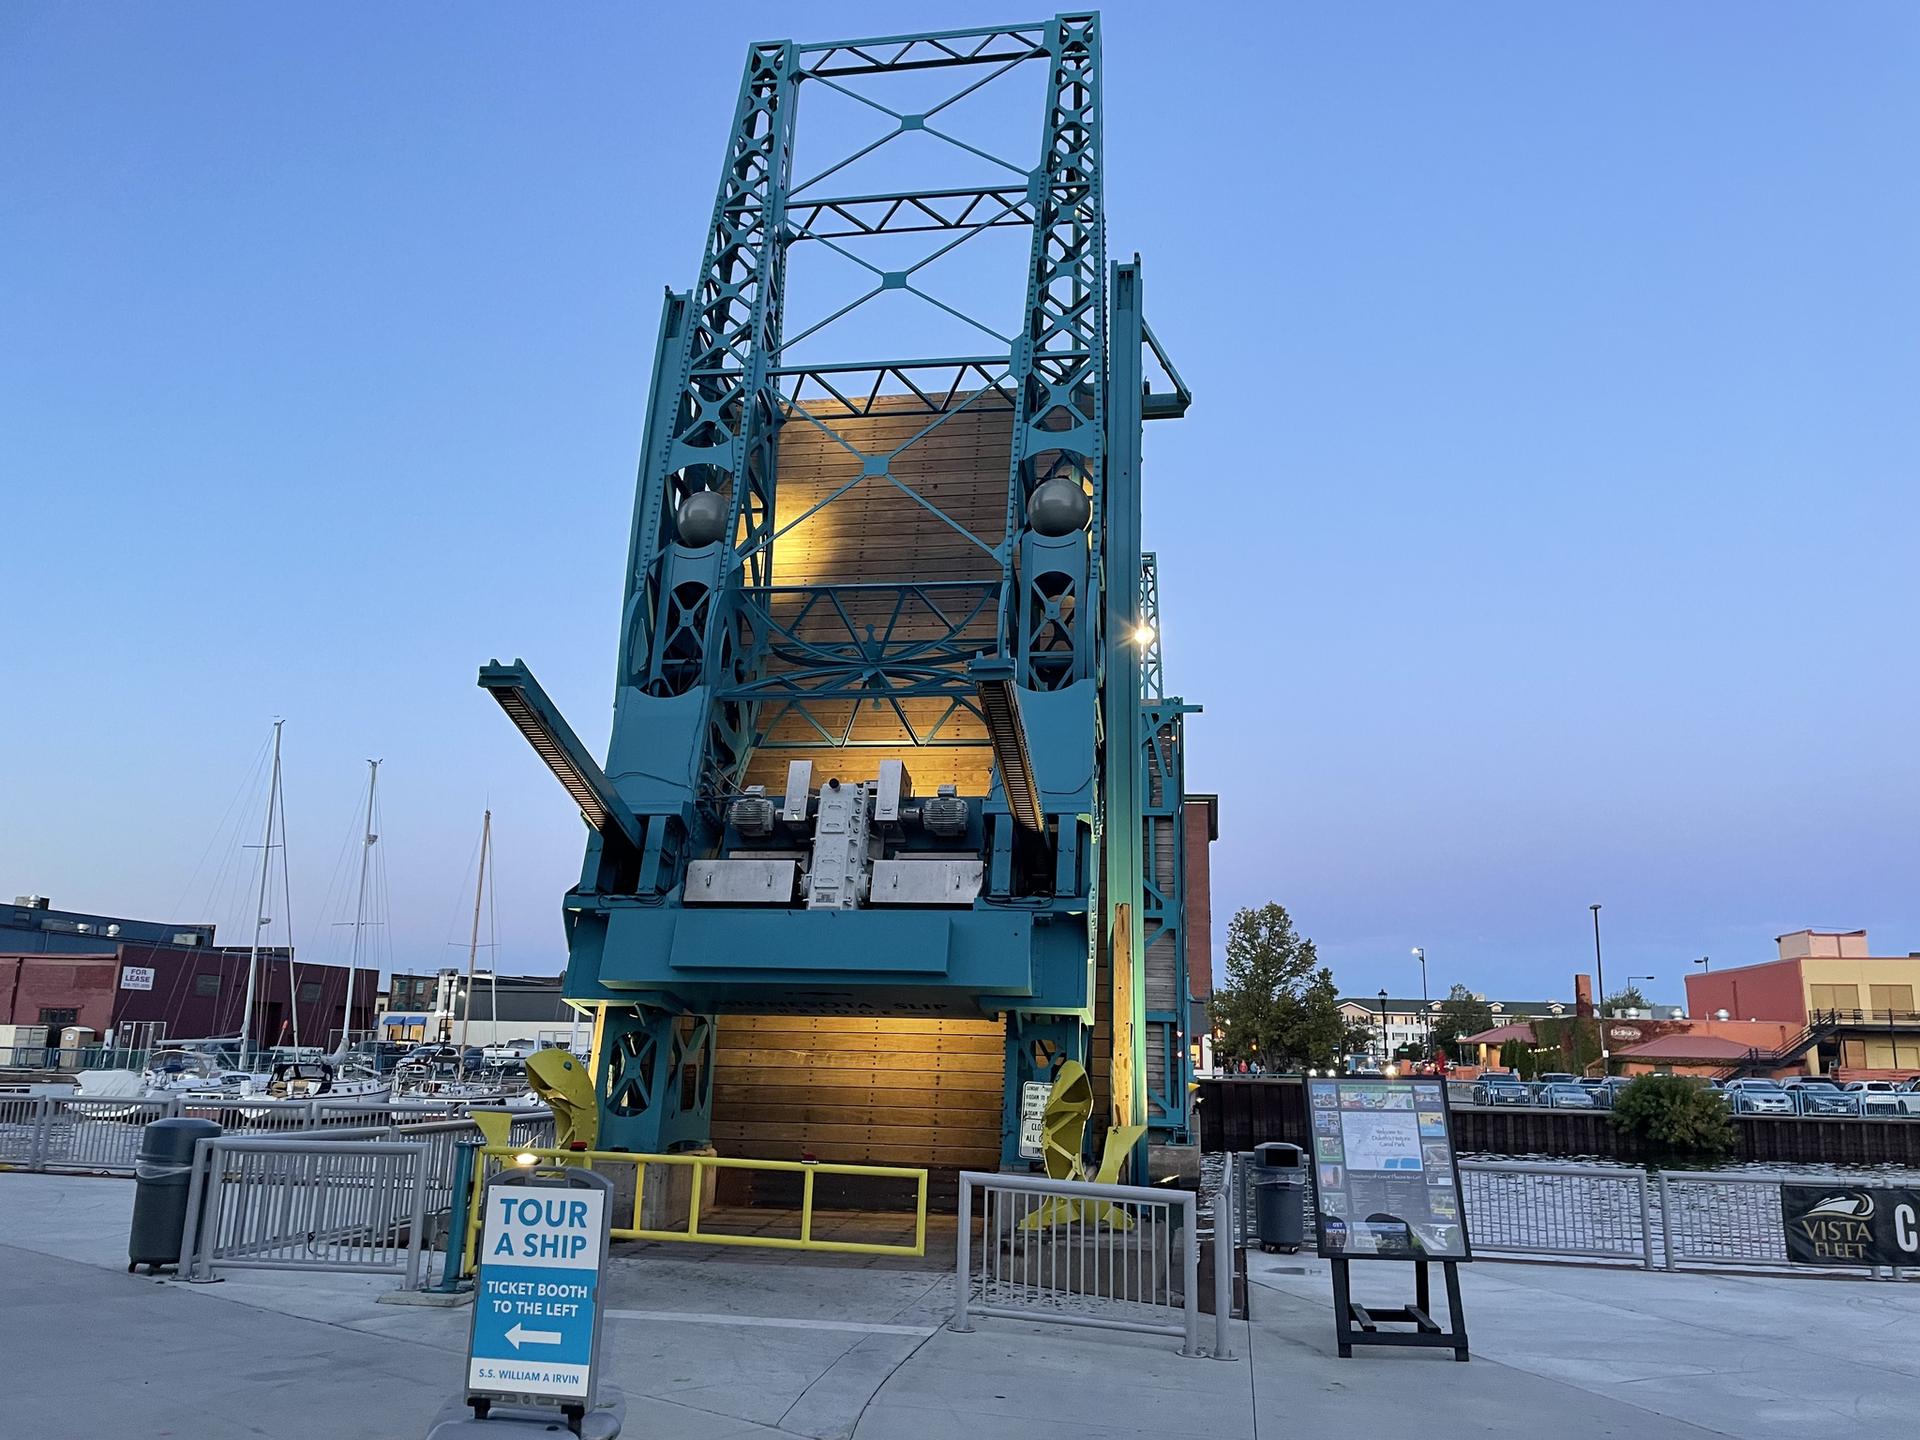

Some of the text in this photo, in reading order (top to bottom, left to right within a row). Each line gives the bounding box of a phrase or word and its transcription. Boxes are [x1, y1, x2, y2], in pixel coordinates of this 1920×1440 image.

[125, 975, 151, 983] LEASE
[892, 1002, 949, 1011] SLIP
[500, 1198, 588, 1228] TOUR
[1802, 1220, 1874, 1242] VISTA
[494, 1232, 587, 1259] A SHIP
[1815, 1242, 1867, 1258] FLEET
[487, 1280, 588, 1299] TICKET BOOTH
[493, 1300, 578, 1317] TO THE LEFT
[479, 1368, 579, 1385] S.S. WILLIAM A IRVIN
